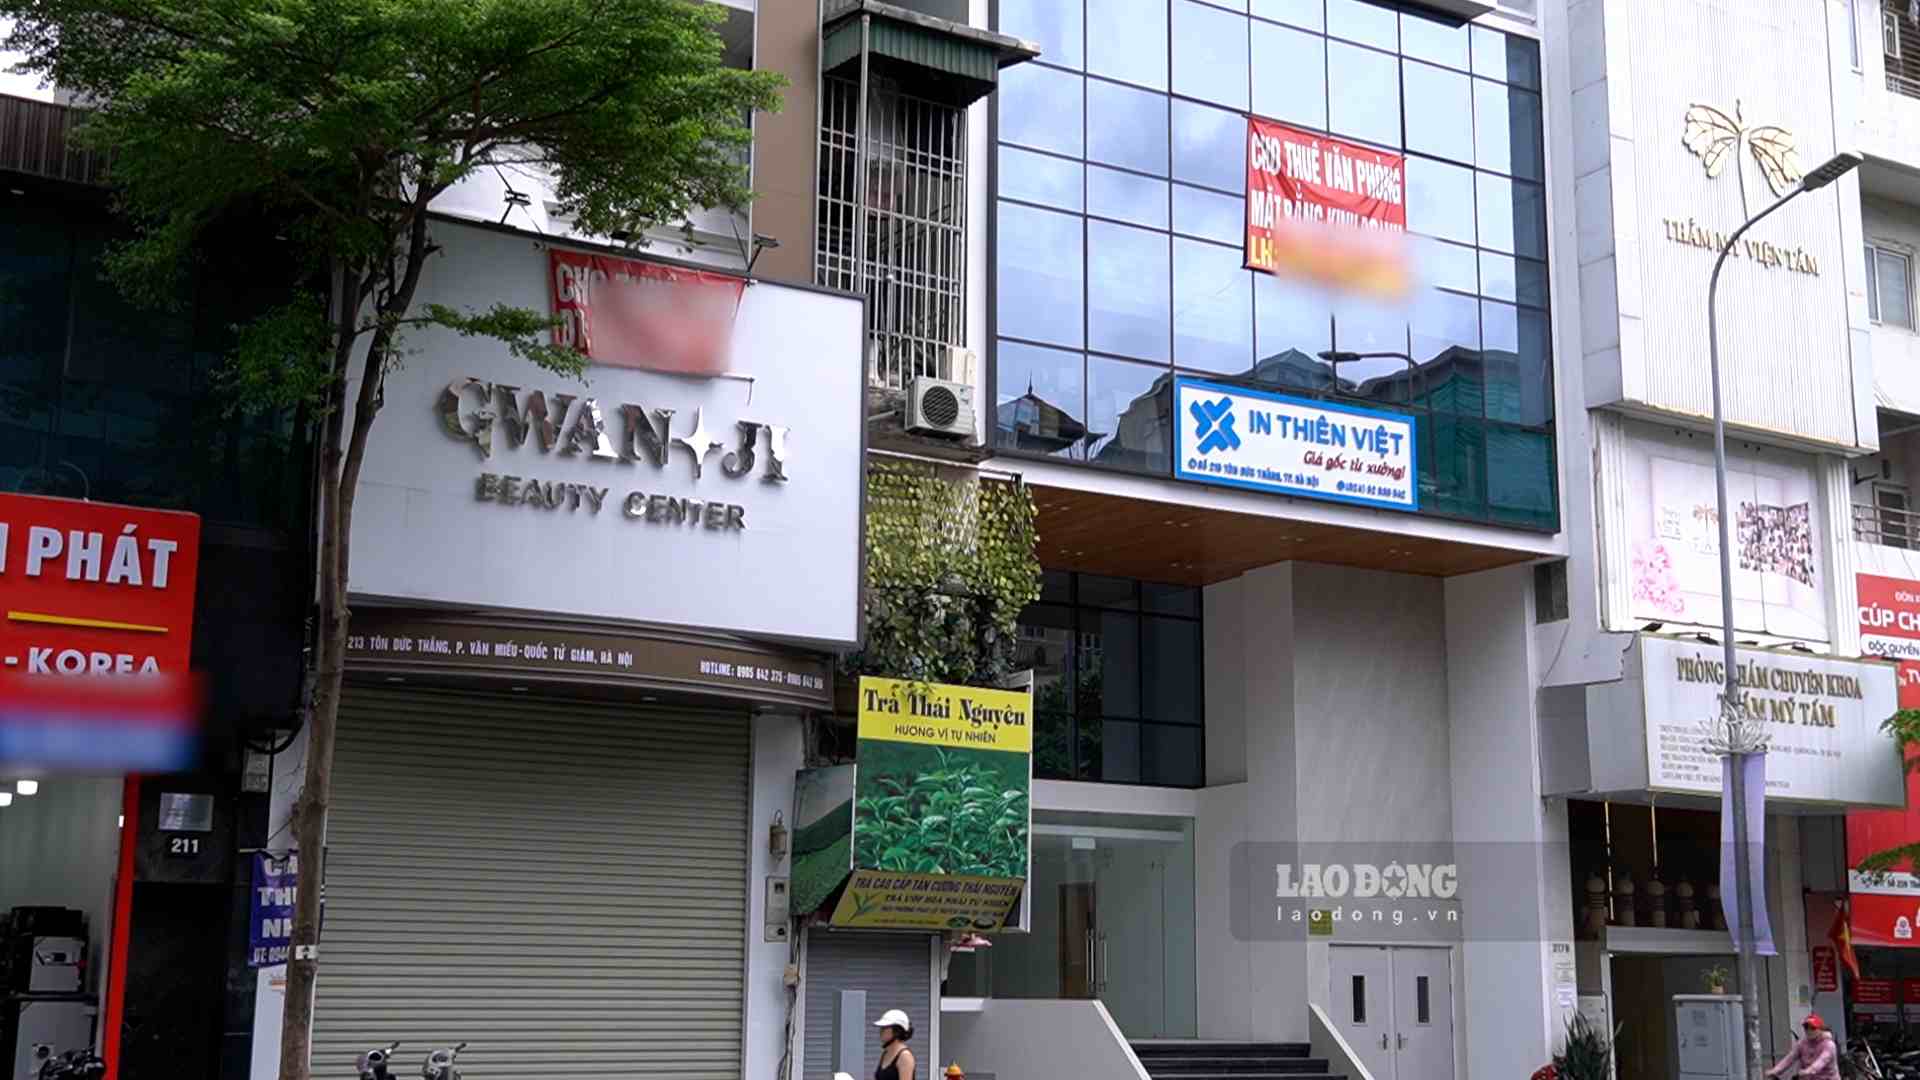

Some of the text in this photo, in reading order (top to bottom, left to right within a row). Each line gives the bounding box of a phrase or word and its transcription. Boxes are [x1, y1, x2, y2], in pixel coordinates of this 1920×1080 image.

[1252, 132, 1401, 205] CHO THUÊ VĂN PHÒNG
[437, 377, 791, 483] GWAN JI
[1249, 409, 1404, 459] IN THIÊN VIỆT
[1304, 450, 1324, 466] Giá
[1326, 452, 1347, 471] gốc
[479, 473, 746, 531] BEAUTY CENTER
[25, 523, 178, 589] PHÁT
[1858, 602, 1895, 628] CÚP
[370, 635, 389, 651] TÔN
[456, 641, 465, 654] P.
[470, 640, 489, 656] VĂN
[700, 660, 735, 676] HOTLINE:
[1676, 652, 1863, 700] PHÒNG HÁM CHUYÊN KHOA
[907, 692, 950, 719] Thái
[959, 698, 1025, 730] Nguyên
[171, 838, 199, 853] 211
